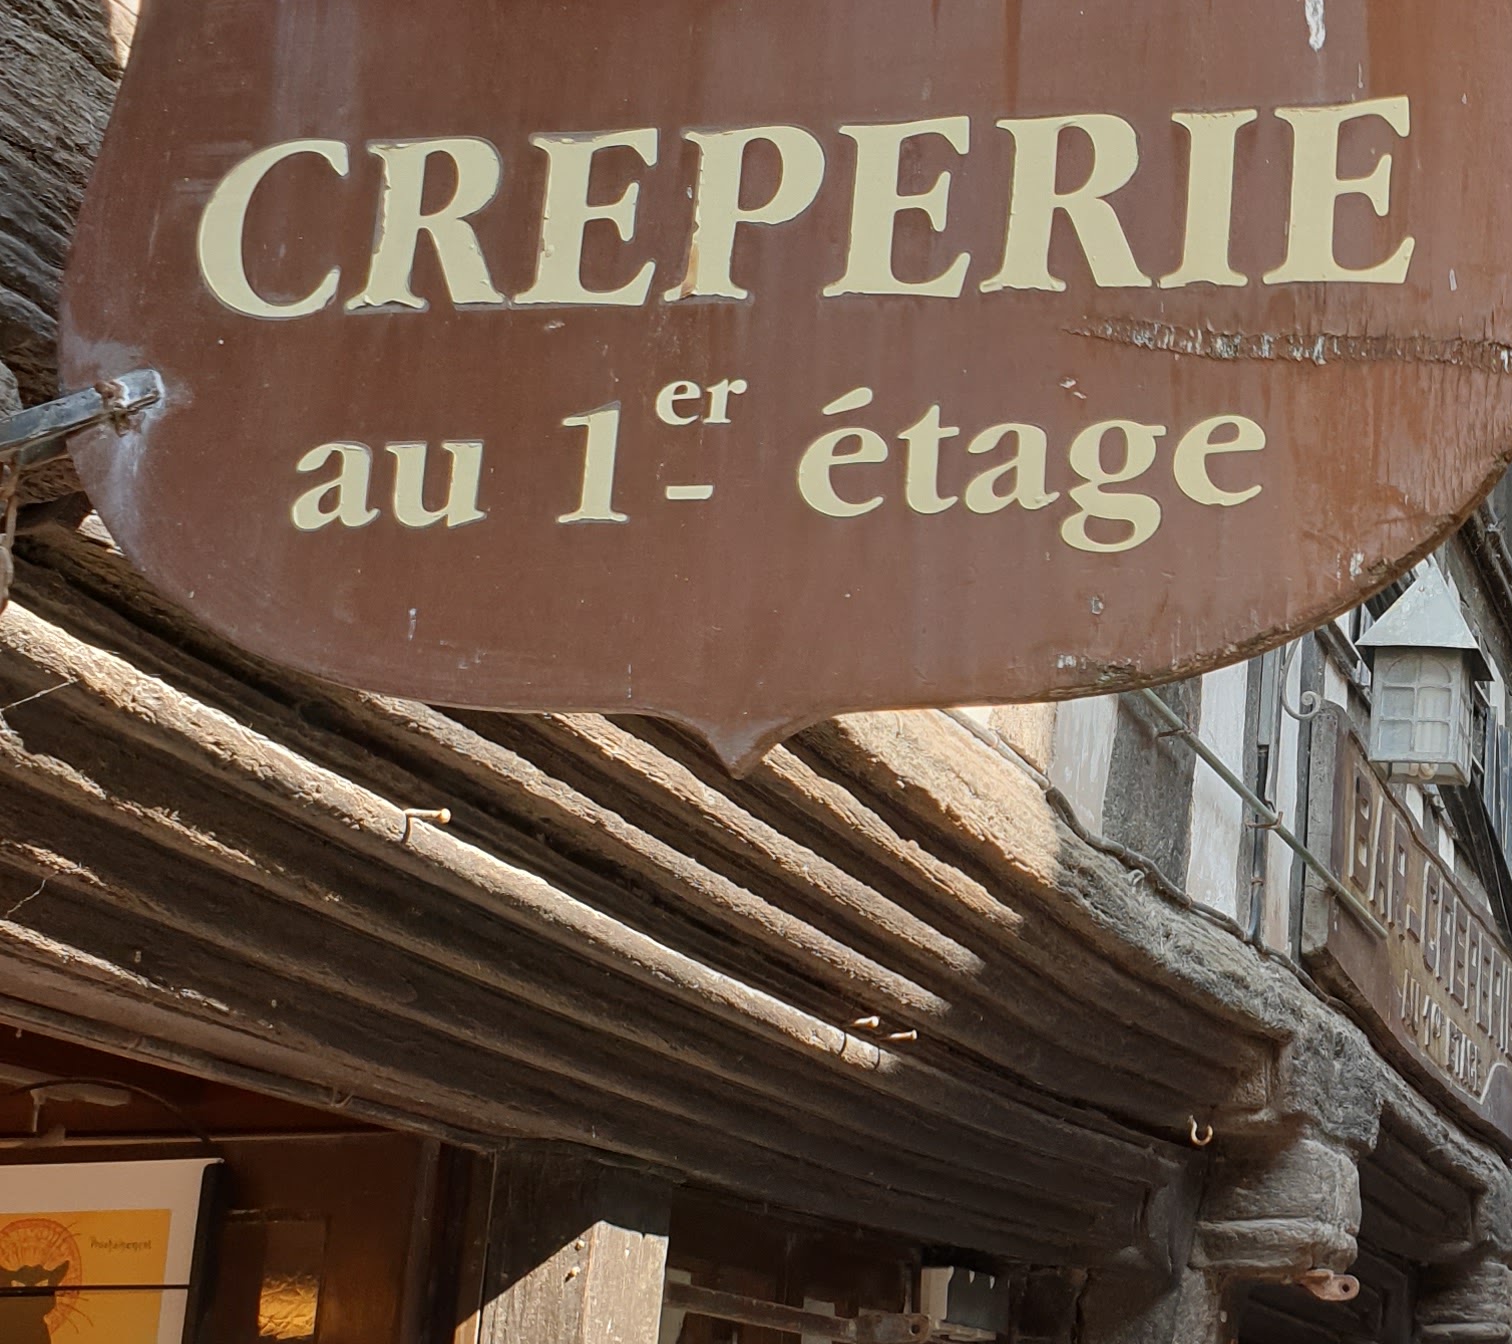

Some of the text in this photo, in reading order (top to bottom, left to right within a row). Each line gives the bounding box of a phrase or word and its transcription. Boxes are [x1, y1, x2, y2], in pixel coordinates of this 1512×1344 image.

[197, 96, 1415, 321] CREPERIE
[291, 441, 487, 531] au
[800, 387, 1268, 554] étage
